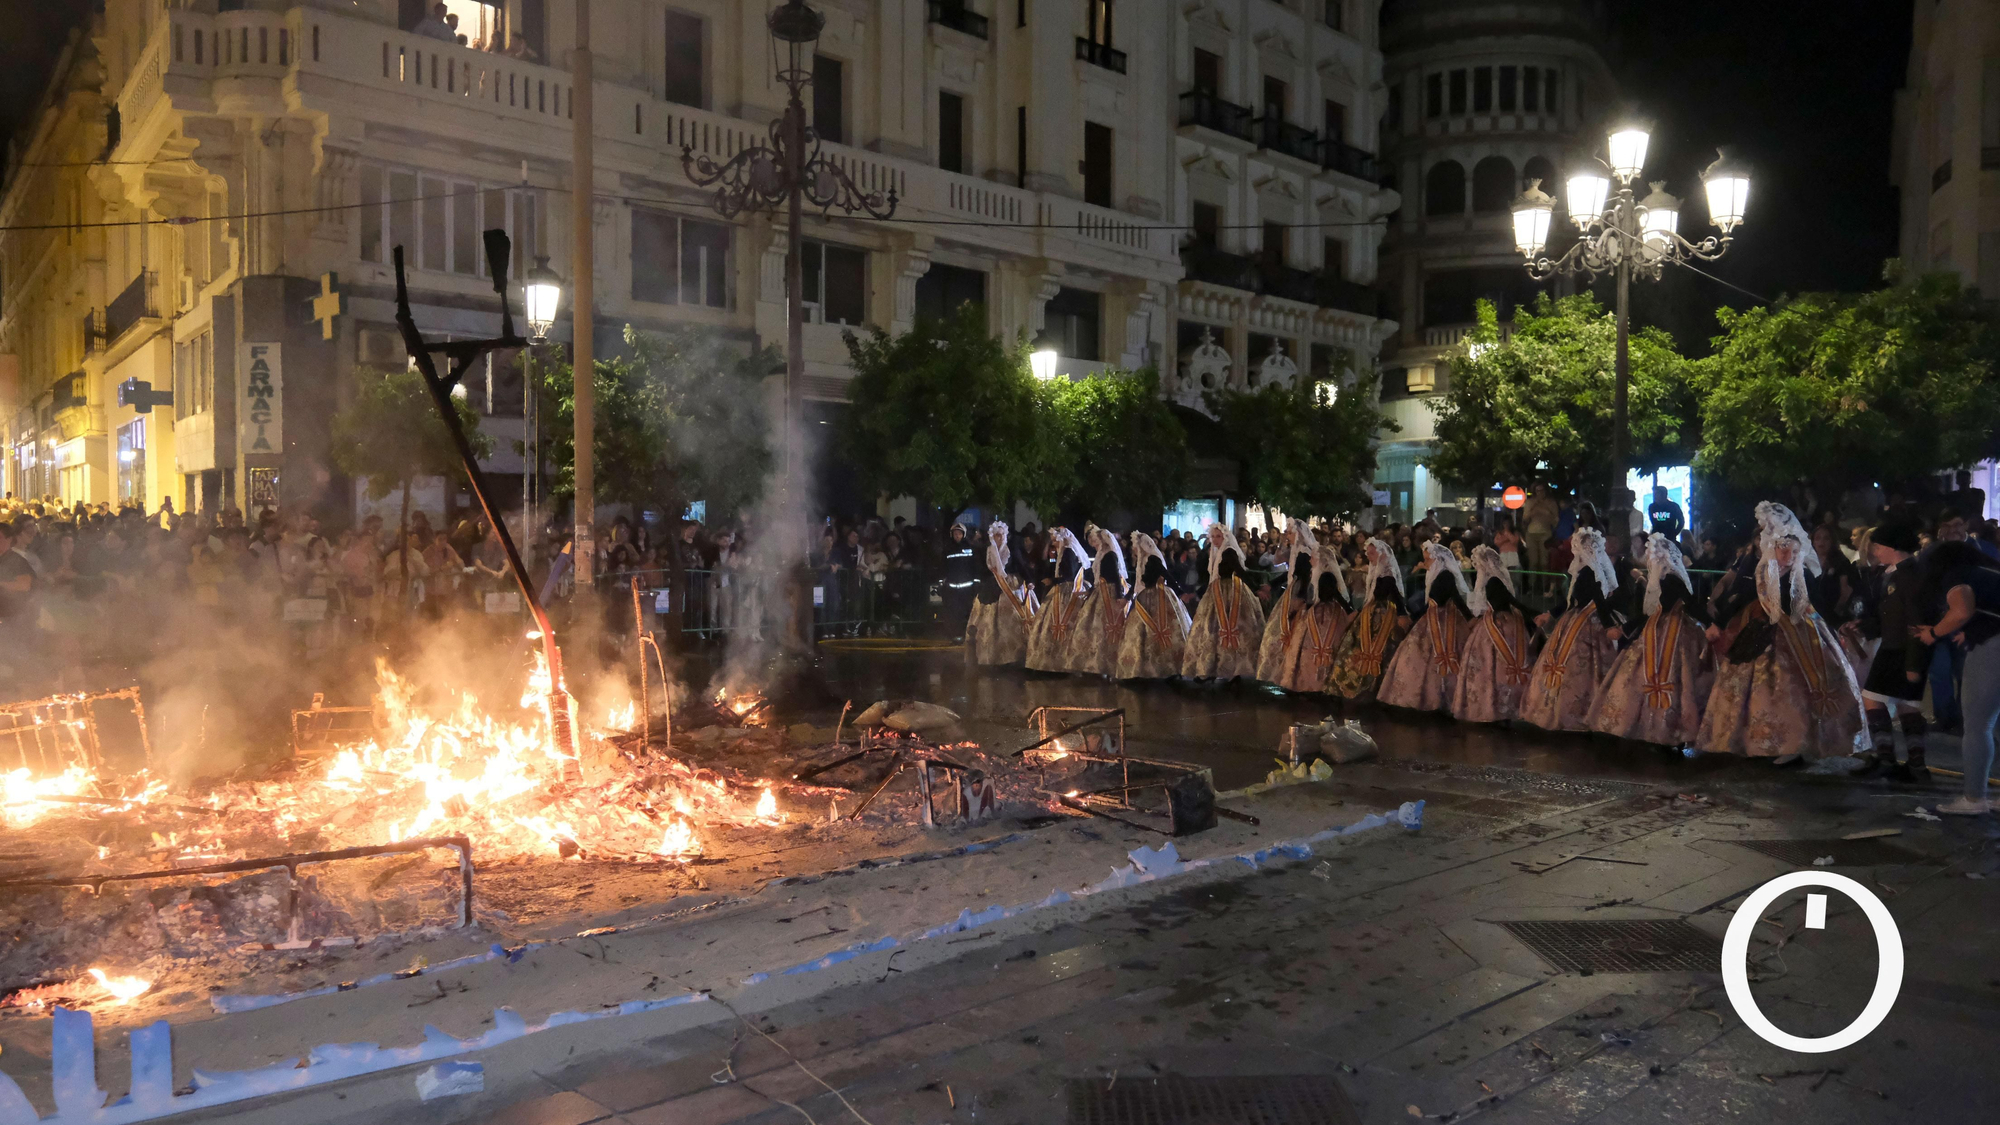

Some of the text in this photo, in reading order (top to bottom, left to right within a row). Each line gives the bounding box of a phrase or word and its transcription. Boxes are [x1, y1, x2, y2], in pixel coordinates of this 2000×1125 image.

[247, 345, 274, 450] FARMACIA
[255, 481, 273, 490] MA
[254, 491, 277, 500] CIA
